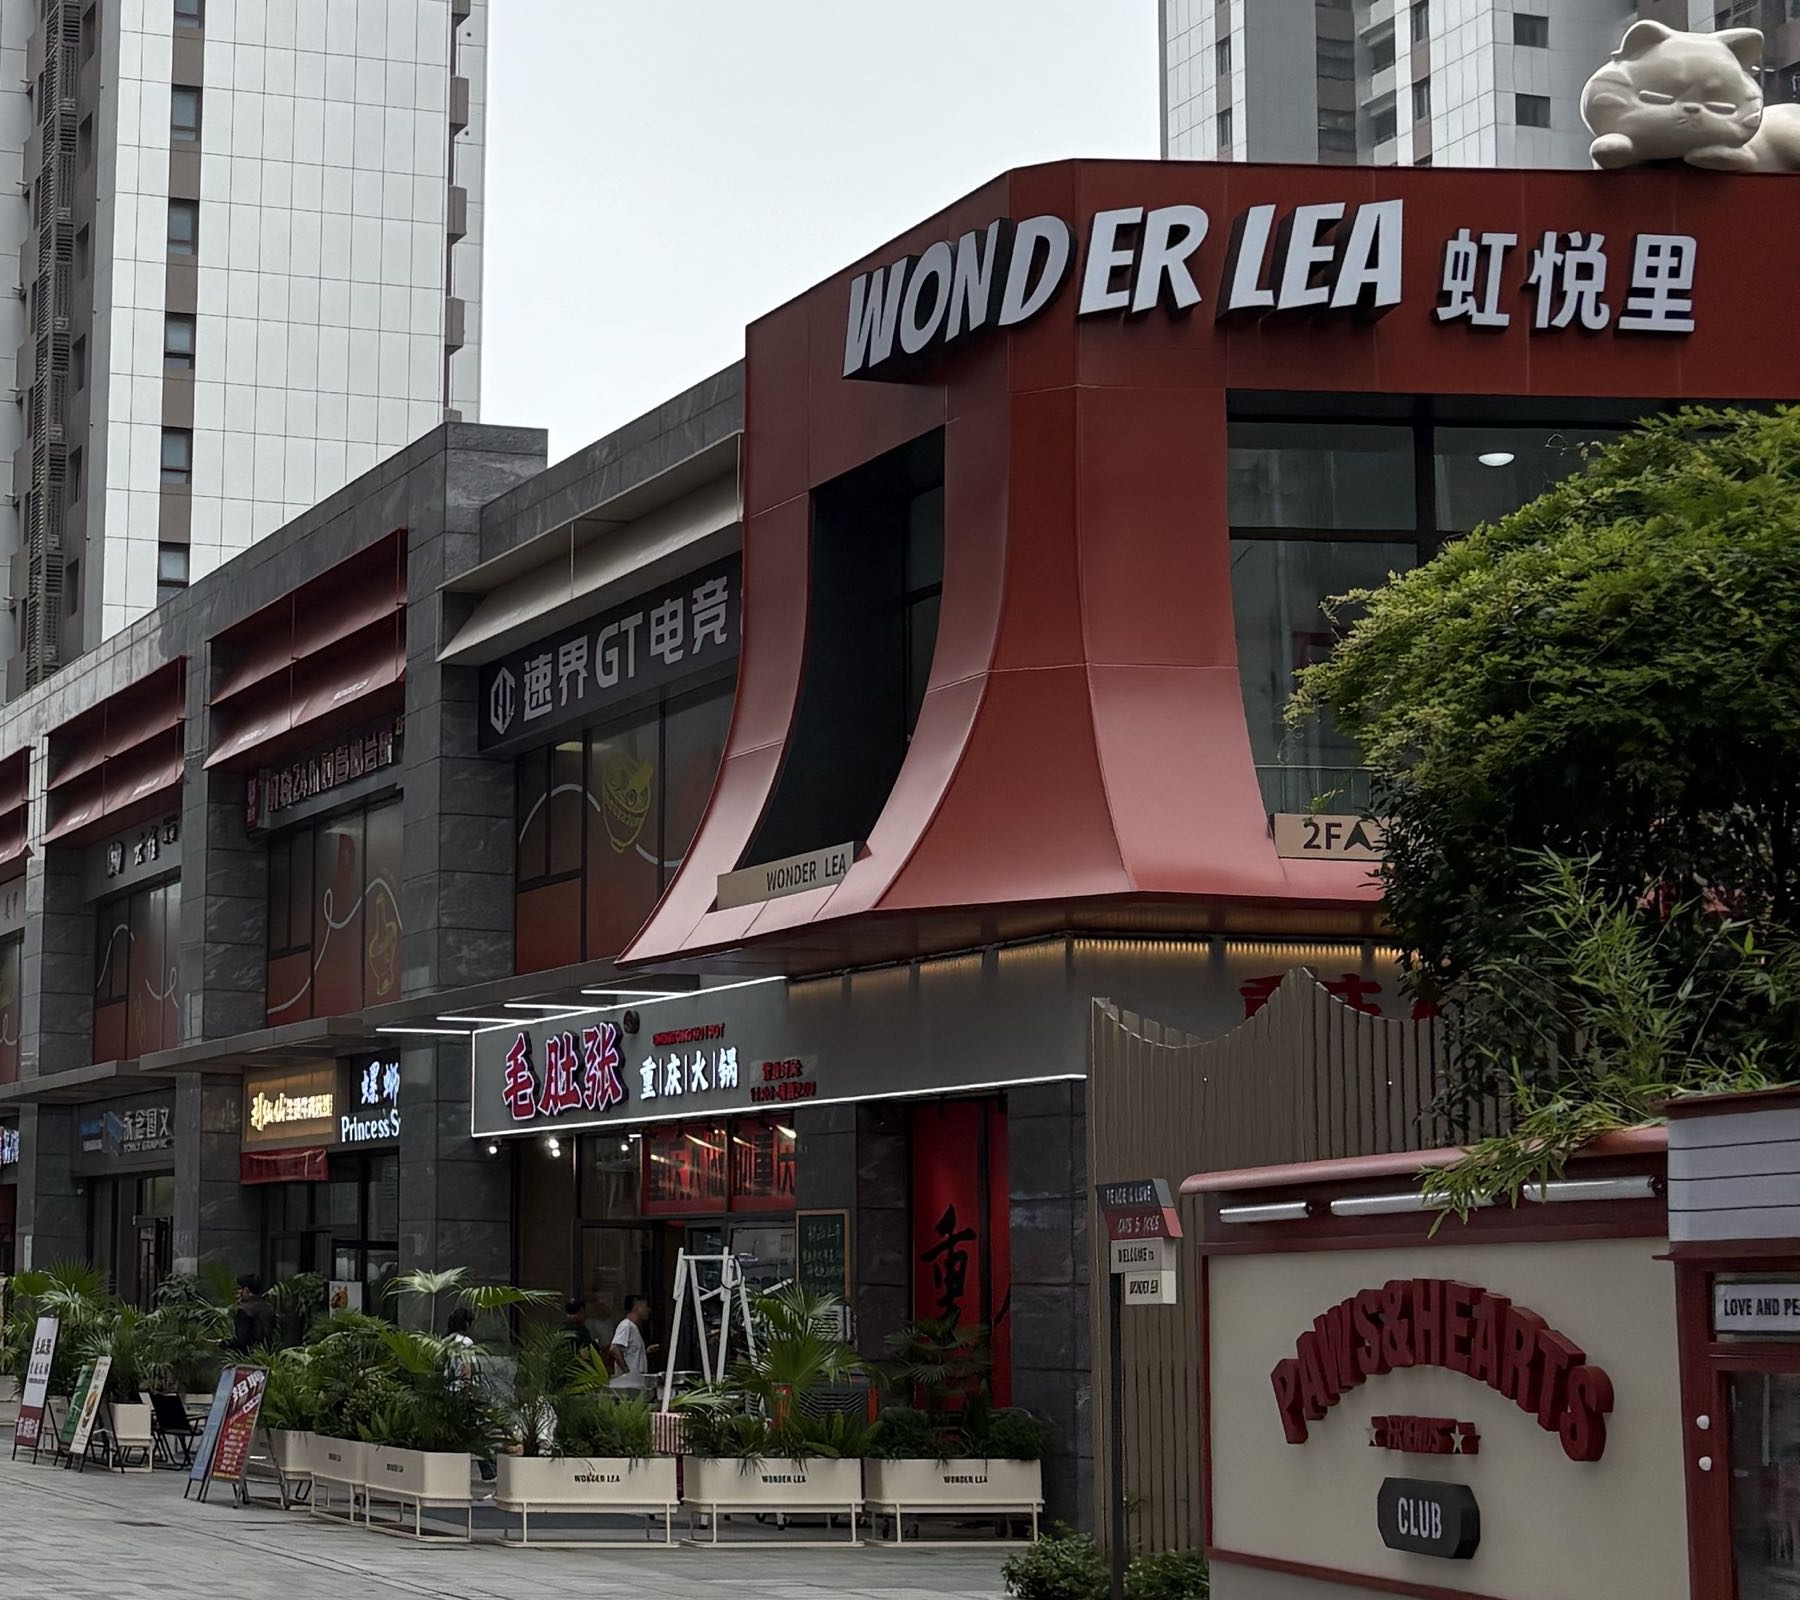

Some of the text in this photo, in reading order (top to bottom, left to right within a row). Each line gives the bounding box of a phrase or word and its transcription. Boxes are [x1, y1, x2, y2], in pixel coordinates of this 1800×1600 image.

[842, 198, 1404, 379] WONDER LEA
[1436, 228, 1697, 332] 虹悦里
[766, 853, 847, 892] WONDER LEA
[502, 1021, 625, 1120] 毛肚张
[1724, 1298, 1752, 1316] LOVE
[1756, 1298, 1780, 1316] AND
[1270, 1278, 1615, 1462] PAWS&HEARTS
[1397, 1497, 1442, 1539] CLUB
